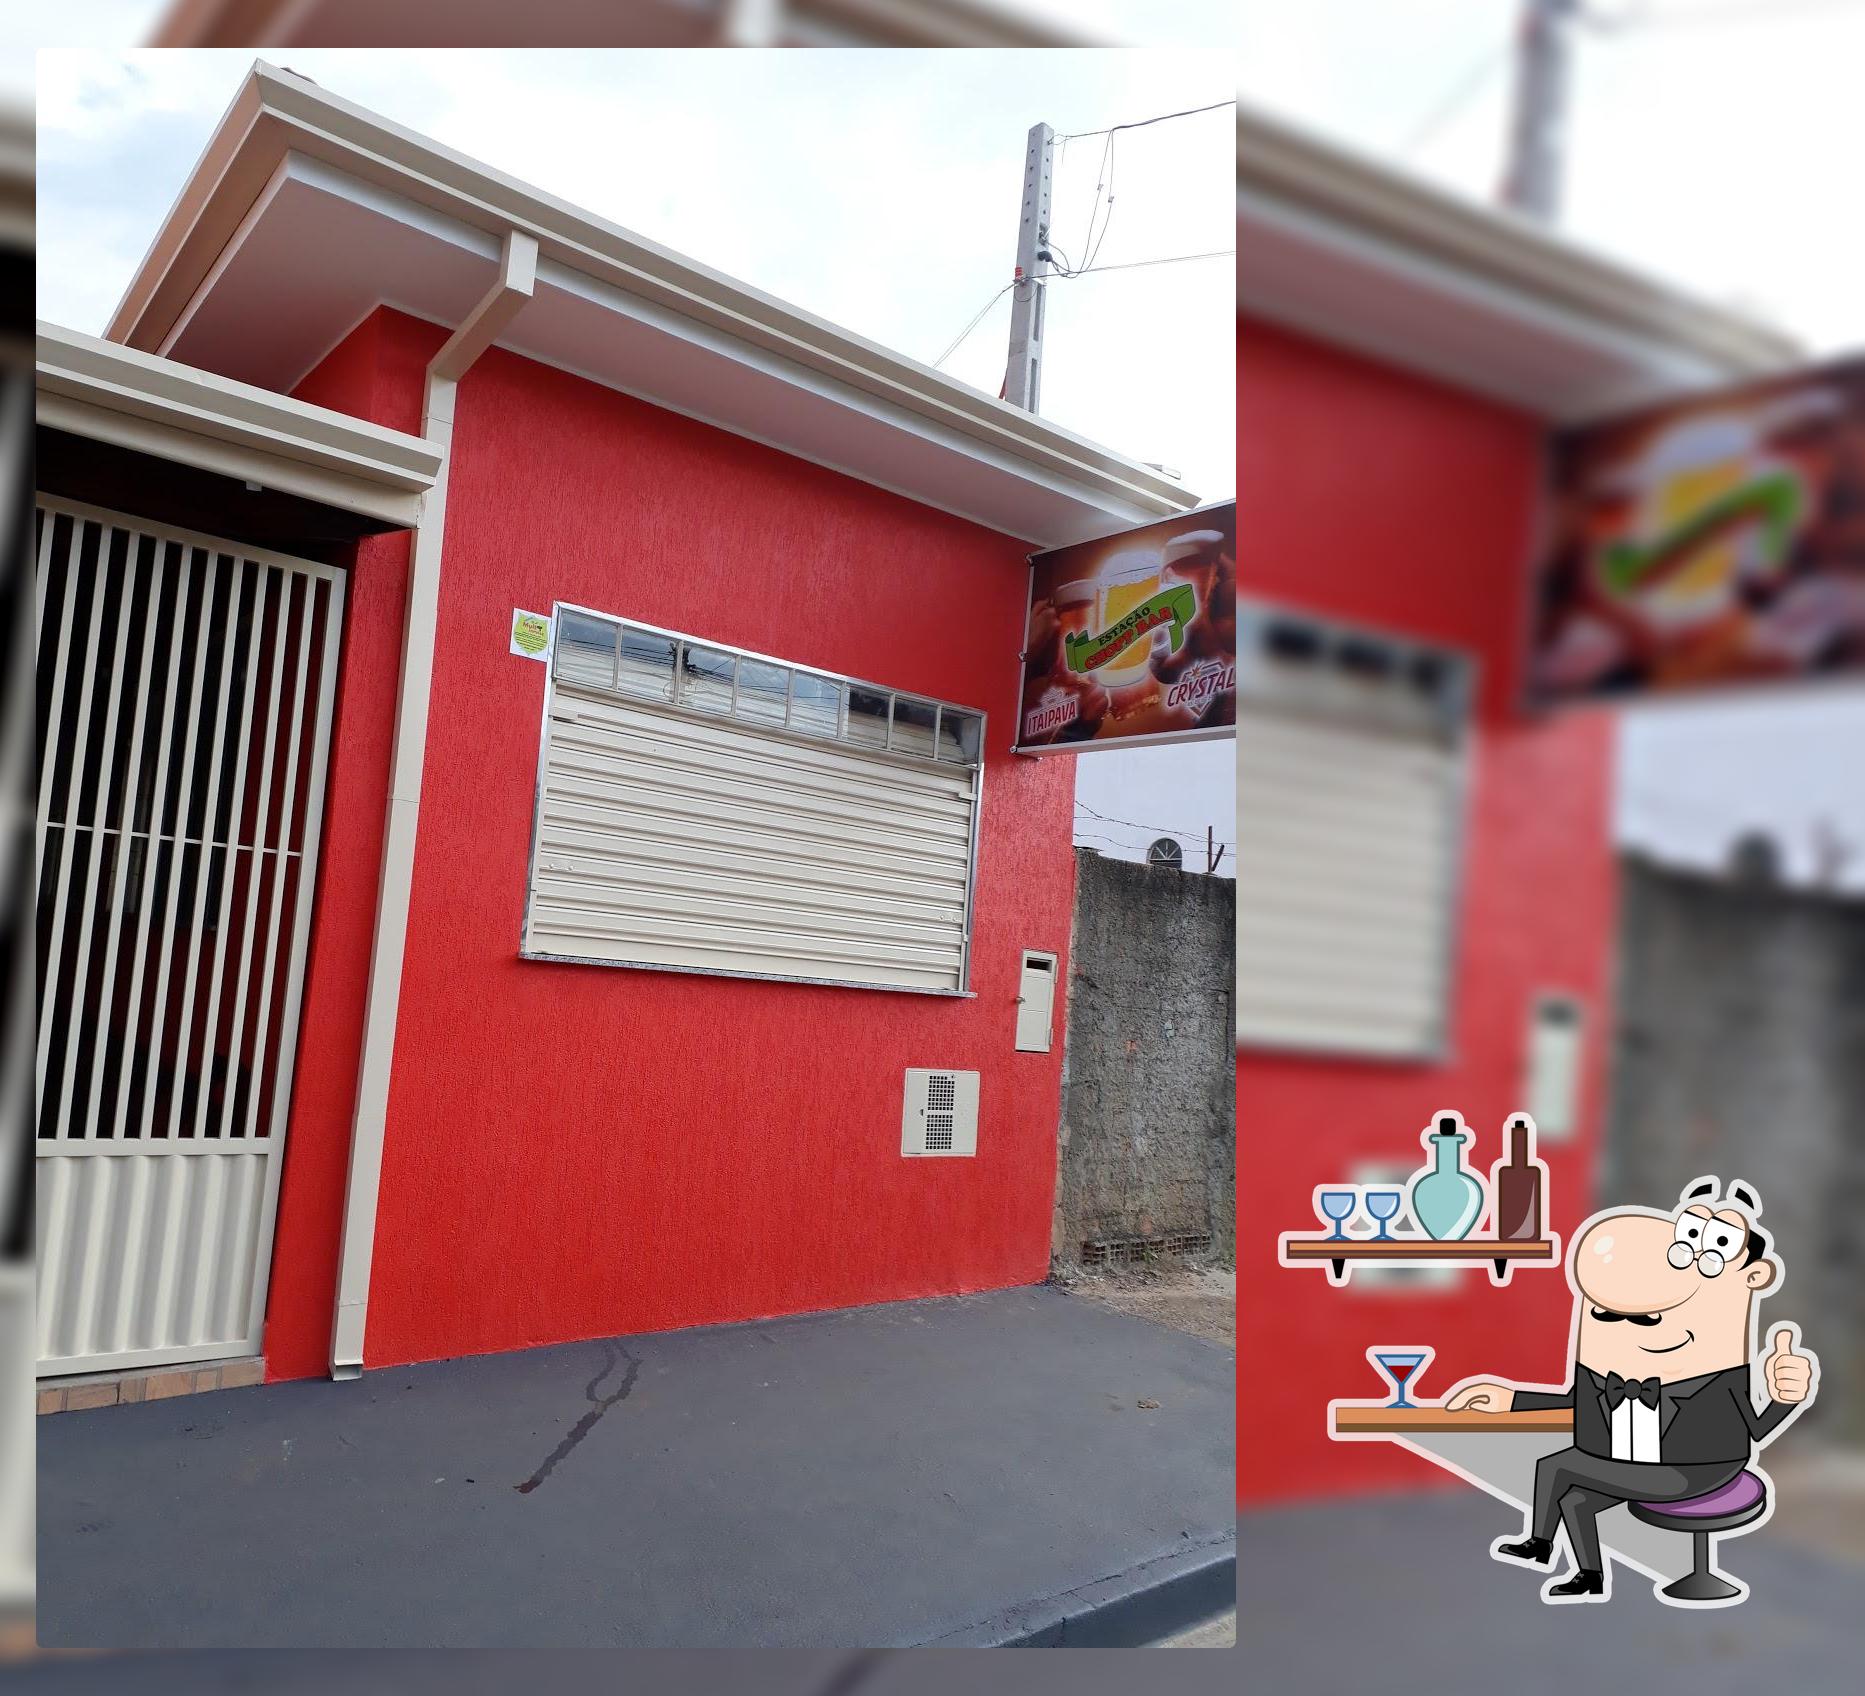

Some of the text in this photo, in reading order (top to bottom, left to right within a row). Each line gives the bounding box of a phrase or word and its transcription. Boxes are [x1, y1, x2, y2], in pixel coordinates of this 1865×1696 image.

[1099, 607, 1151, 646] ESTAÇÃO
[1167, 667, 1235, 707] CRYSTAL
[1027, 701, 1076, 735] ITAIPAVA
